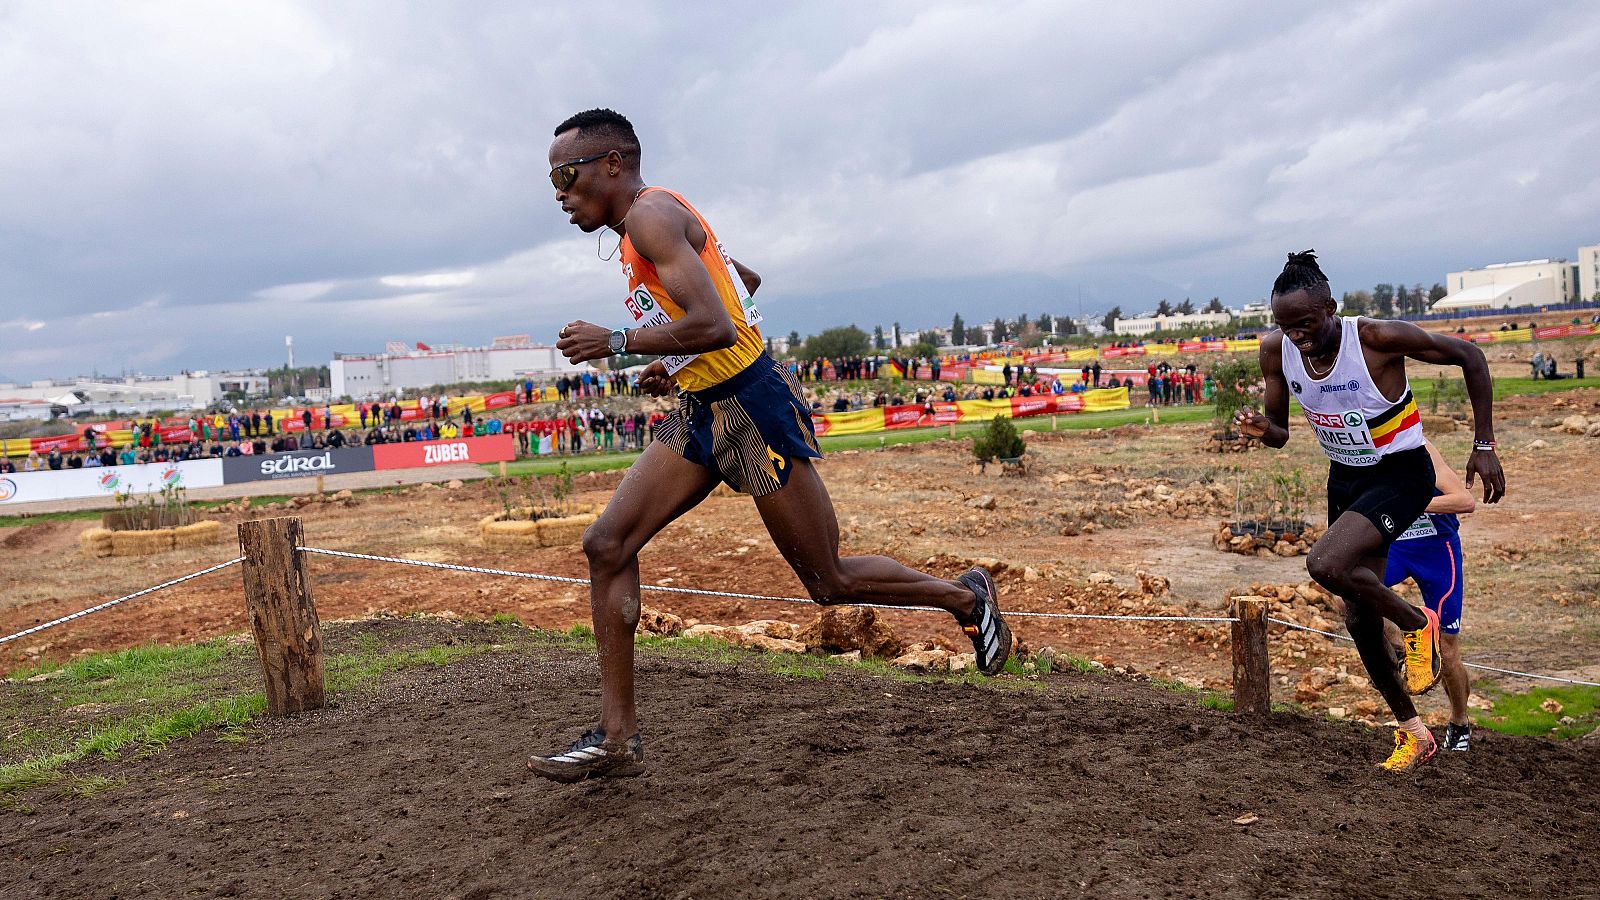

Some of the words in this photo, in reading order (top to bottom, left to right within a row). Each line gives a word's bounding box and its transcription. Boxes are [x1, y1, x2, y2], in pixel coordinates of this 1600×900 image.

[1320, 384, 1347, 393] Allianz
[1305, 410, 1343, 427] SPAR
[423, 442, 470, 464] ZÜBER
[1354, 456, 1378, 465] 2024
[1416, 528, 1434, 536] 2024
